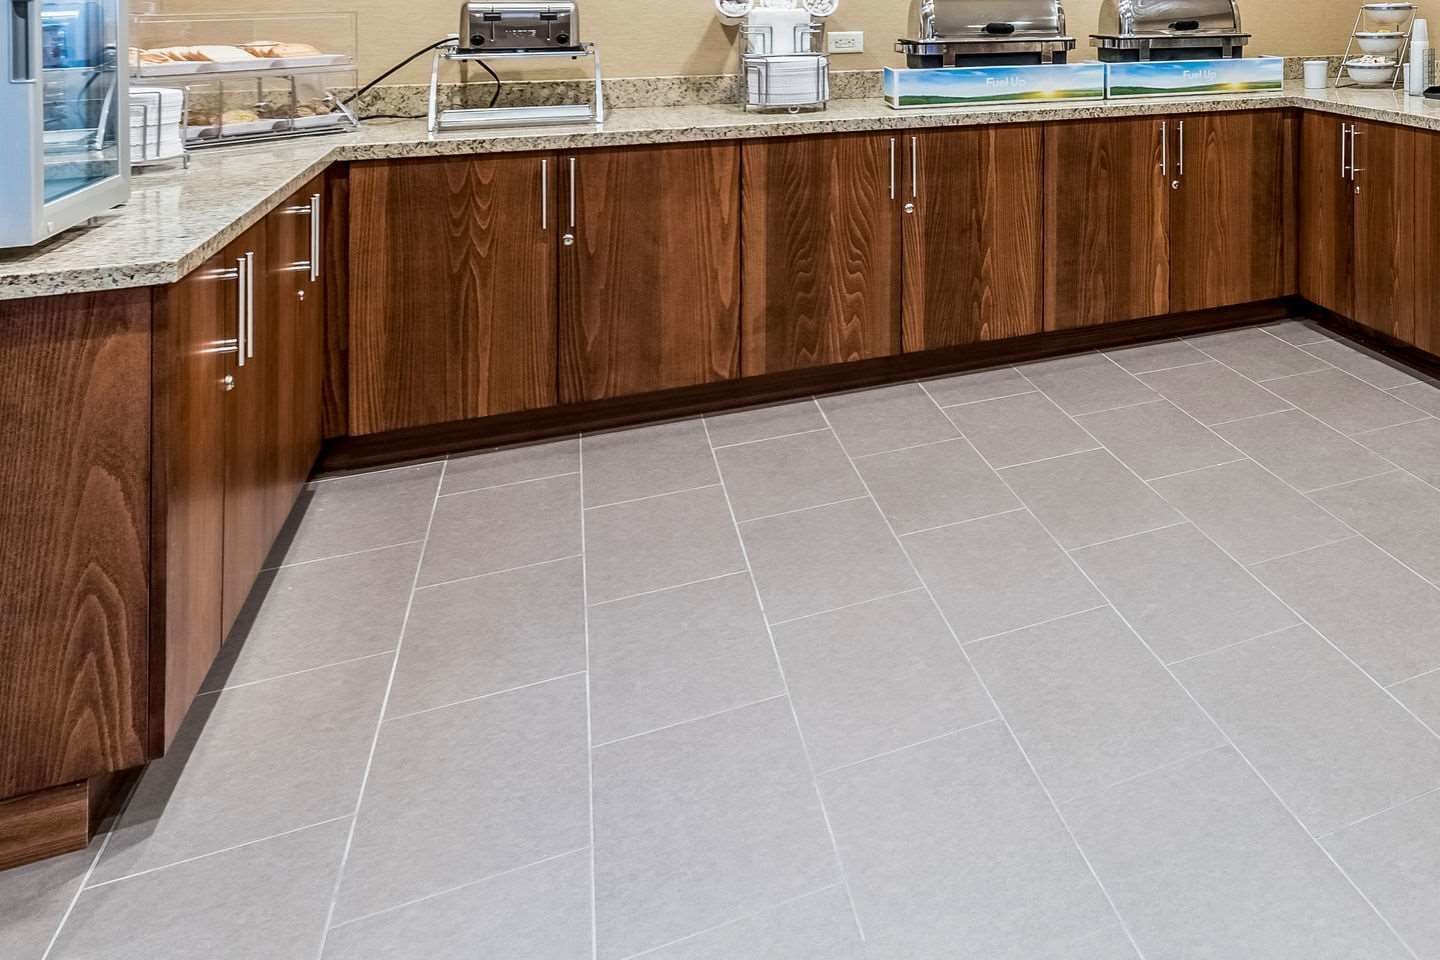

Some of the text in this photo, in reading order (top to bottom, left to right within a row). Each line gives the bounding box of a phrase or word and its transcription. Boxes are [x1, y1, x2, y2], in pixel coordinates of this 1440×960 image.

[1183, 69, 1216, 82] Fuel Up
[985, 76, 1026, 89] Fuel Up
